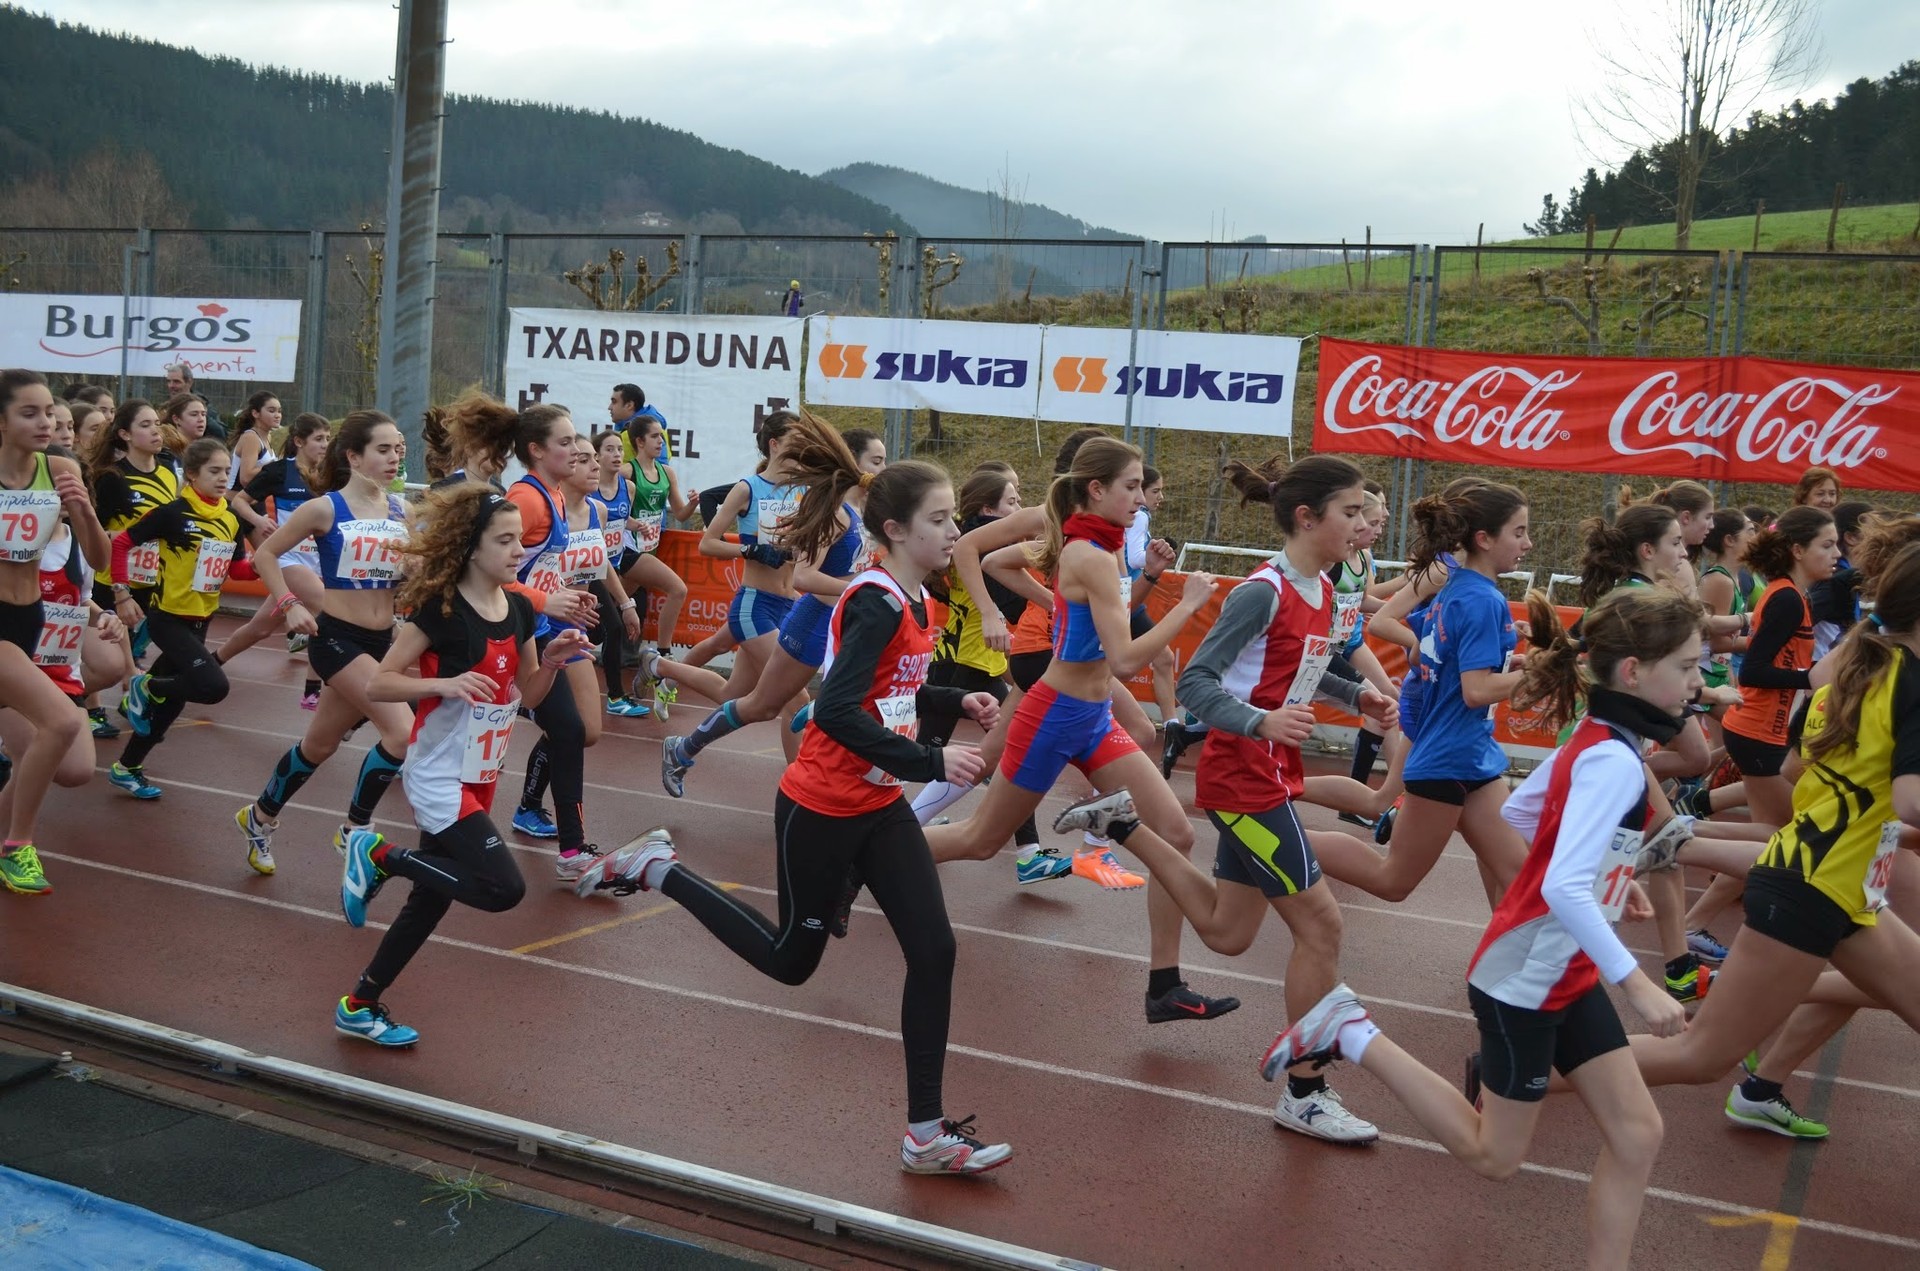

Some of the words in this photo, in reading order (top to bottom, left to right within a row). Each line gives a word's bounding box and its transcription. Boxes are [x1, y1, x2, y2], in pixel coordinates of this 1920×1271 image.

[45, 304, 252, 352] Burgos
[523, 326, 791, 371] TXARRIDUNA
[1323, 355, 1582, 452] Coca-Cola
[1608, 371, 1901, 468] Coca-Cola
[559, 545, 604, 573] 1720
